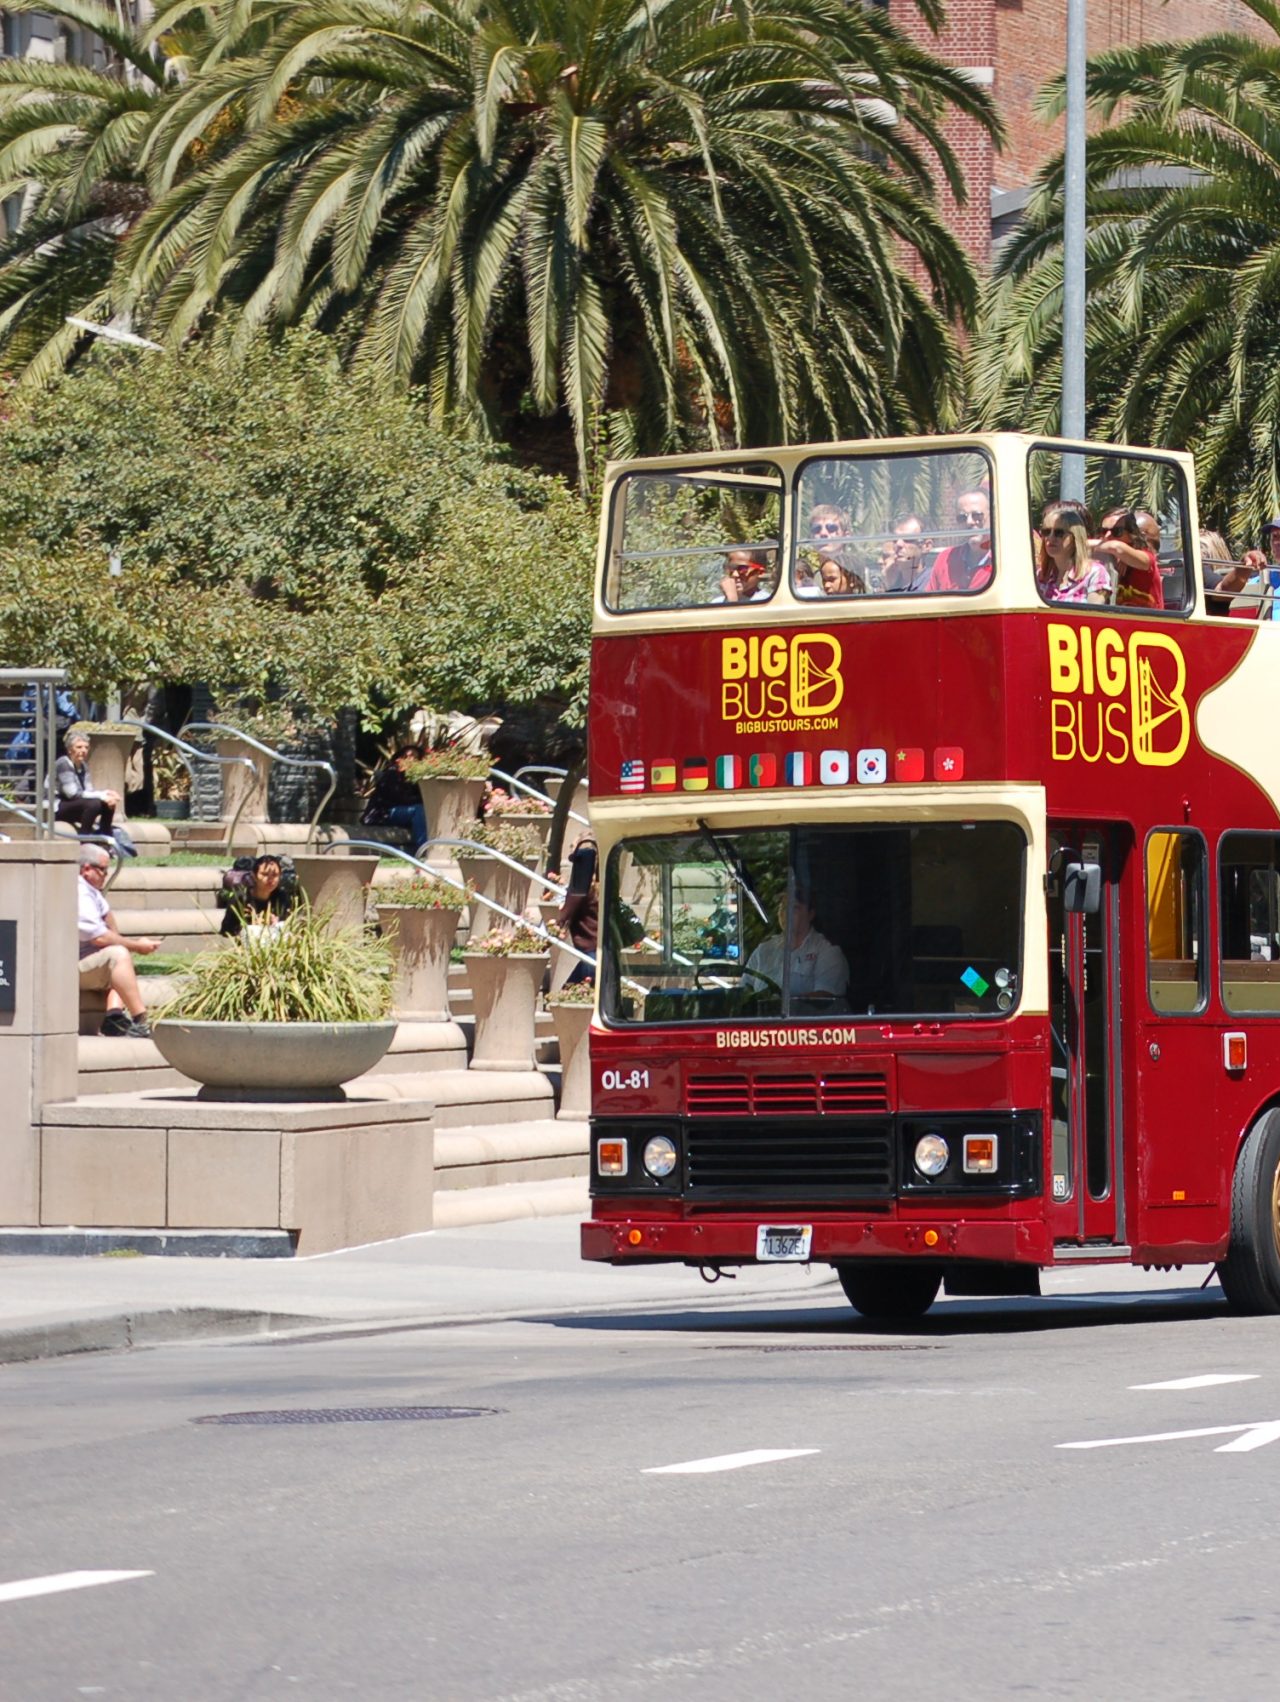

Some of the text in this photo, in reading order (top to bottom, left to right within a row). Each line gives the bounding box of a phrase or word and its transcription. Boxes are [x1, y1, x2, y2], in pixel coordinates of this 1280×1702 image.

[722, 635, 788, 680] BIG
[1047, 623, 1127, 697] BIG
[722, 680, 788, 720] BUS
[736, 718, 839, 734] BIGBUSTOURS.COM
[1051, 699, 1129, 764] BUS
[716, 1028, 856, 1048] BIGBUSTOURS.COM
[601, 1070, 650, 1090] OL-81
[761, 1238, 806, 1256] 71362E1
